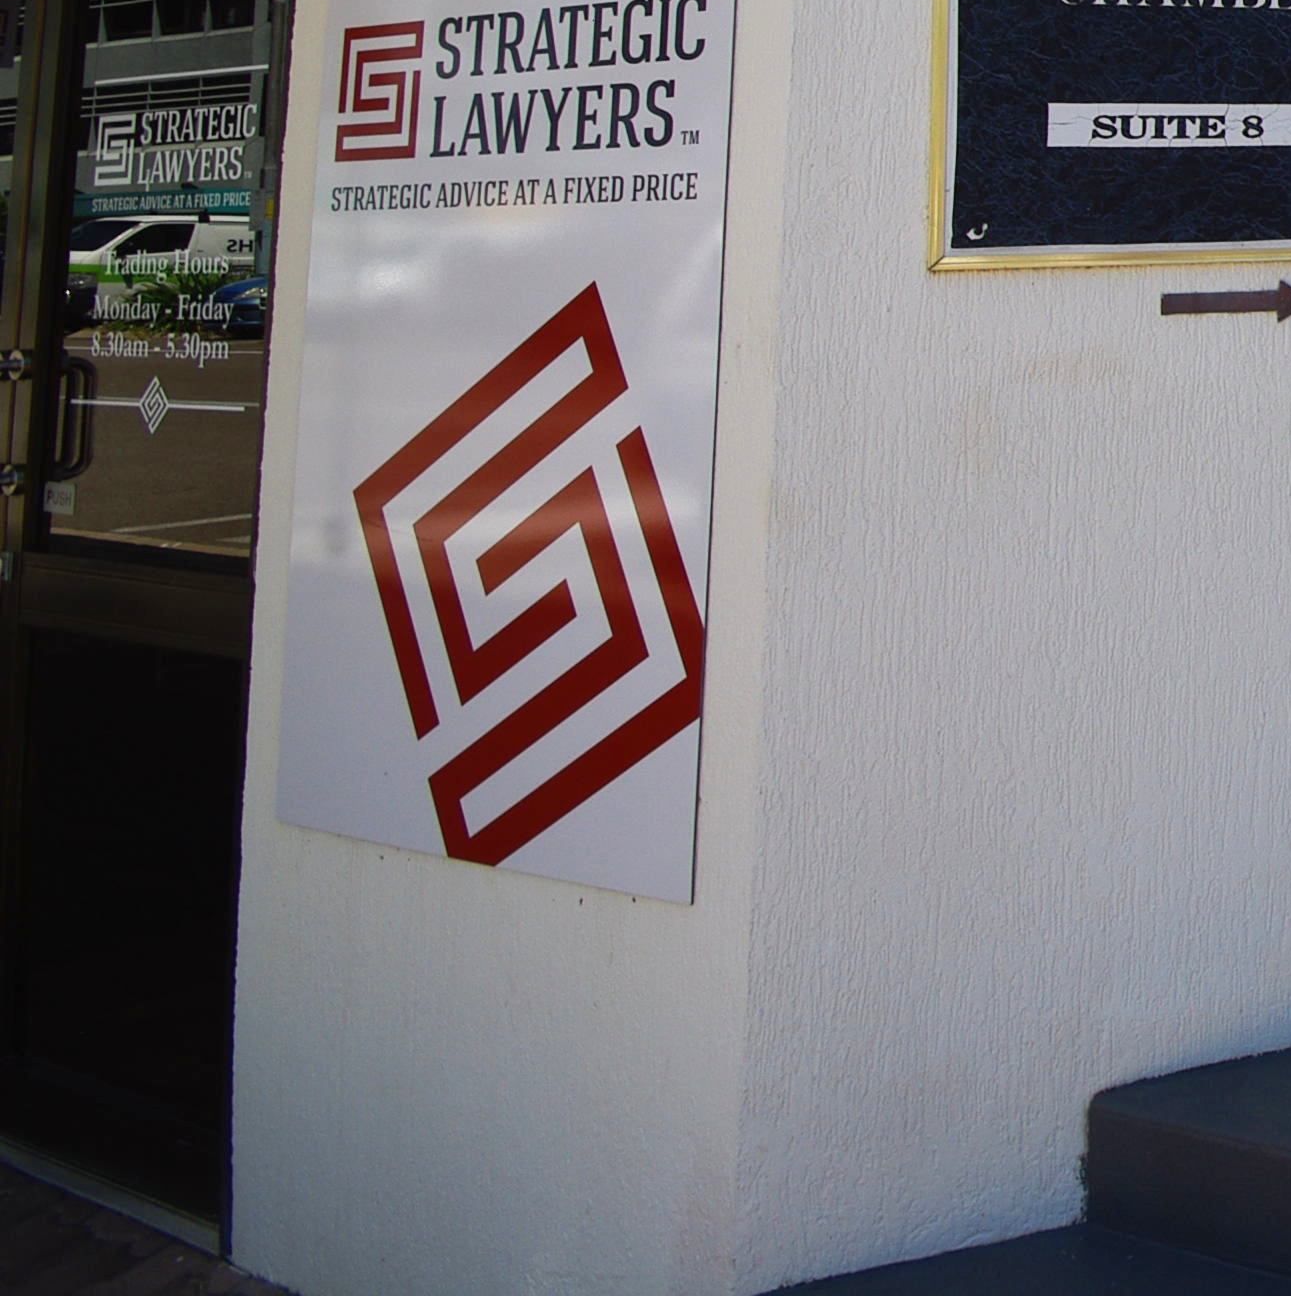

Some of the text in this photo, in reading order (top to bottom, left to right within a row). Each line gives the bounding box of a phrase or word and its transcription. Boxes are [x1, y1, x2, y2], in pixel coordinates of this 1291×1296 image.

[140, 104, 258, 144] STRATEGIC
[429, 79, 676, 159] LAWYERS
[1090, 114, 1265, 141] SUITE 8
[137, 146, 244, 185] LAWYERS
[91, 191, 251, 213] STRATEGIC ADVICE AT A FIXED PRICE
[331, 172, 699, 212] STRATEGIC ADVICE AT A FIXED PRICE
[104, 249, 230, 284] Trading Hours
[92, 294, 161, 328] Monday
[176, 293, 234, 330] Friday
[91, 331, 149, 358] 8.30am
[164, 332, 230, 369] 5.30pm
